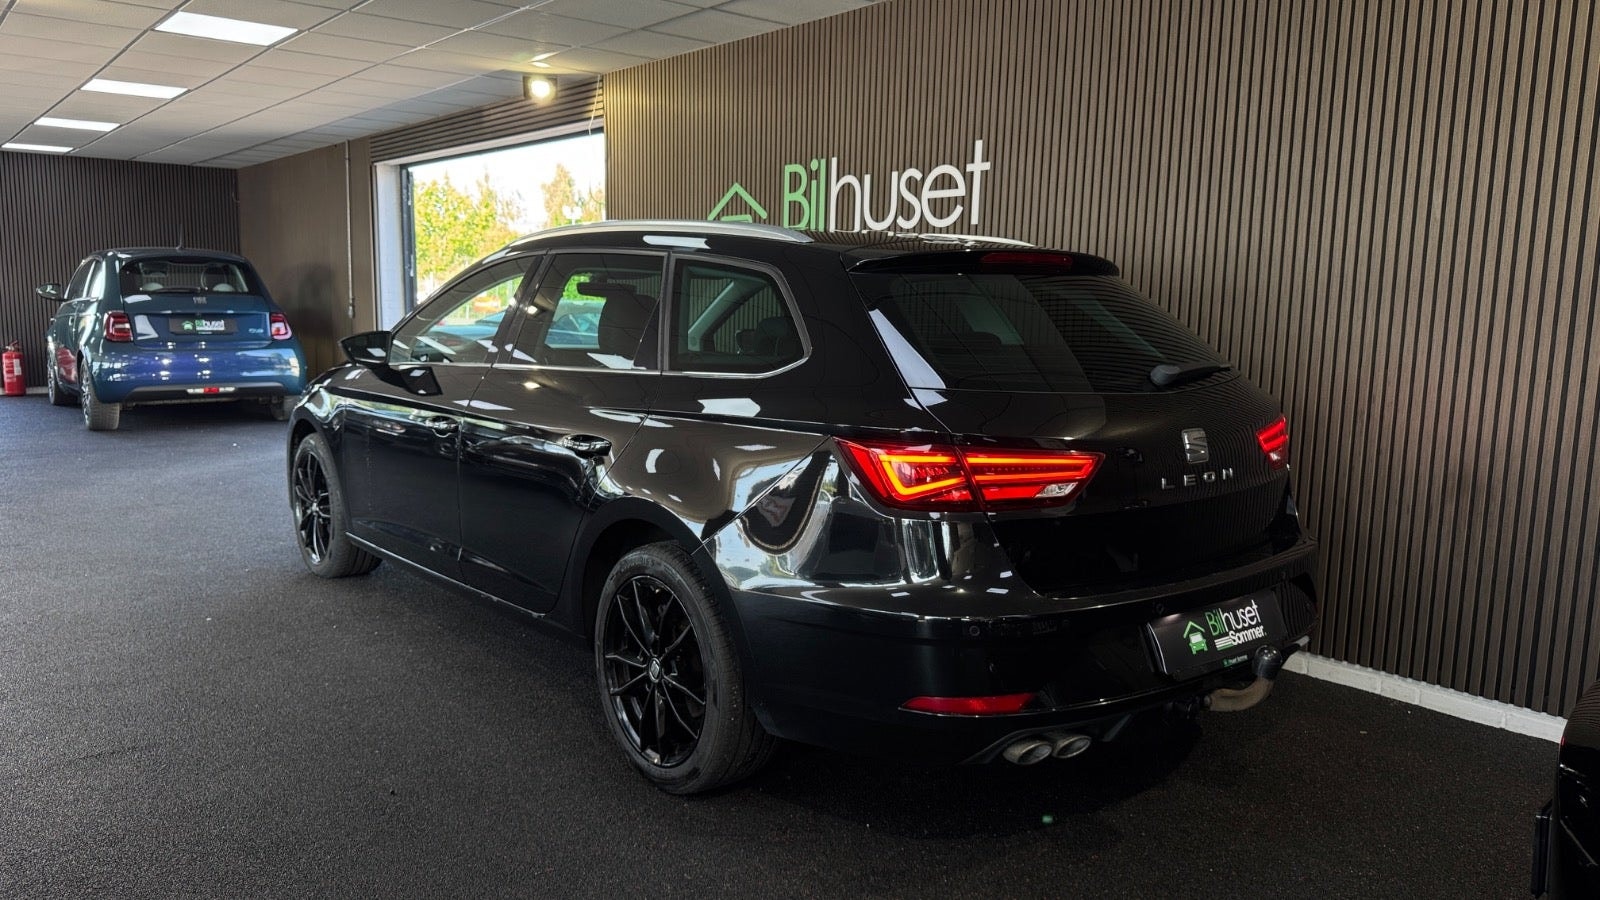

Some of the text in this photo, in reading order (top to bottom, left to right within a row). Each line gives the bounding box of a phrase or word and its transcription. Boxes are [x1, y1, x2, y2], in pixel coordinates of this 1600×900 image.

[783, 139, 991, 233] Bilhuset
[1161, 467, 1233, 490] LEON
[1205, 599, 1262, 636] Bilhuset
